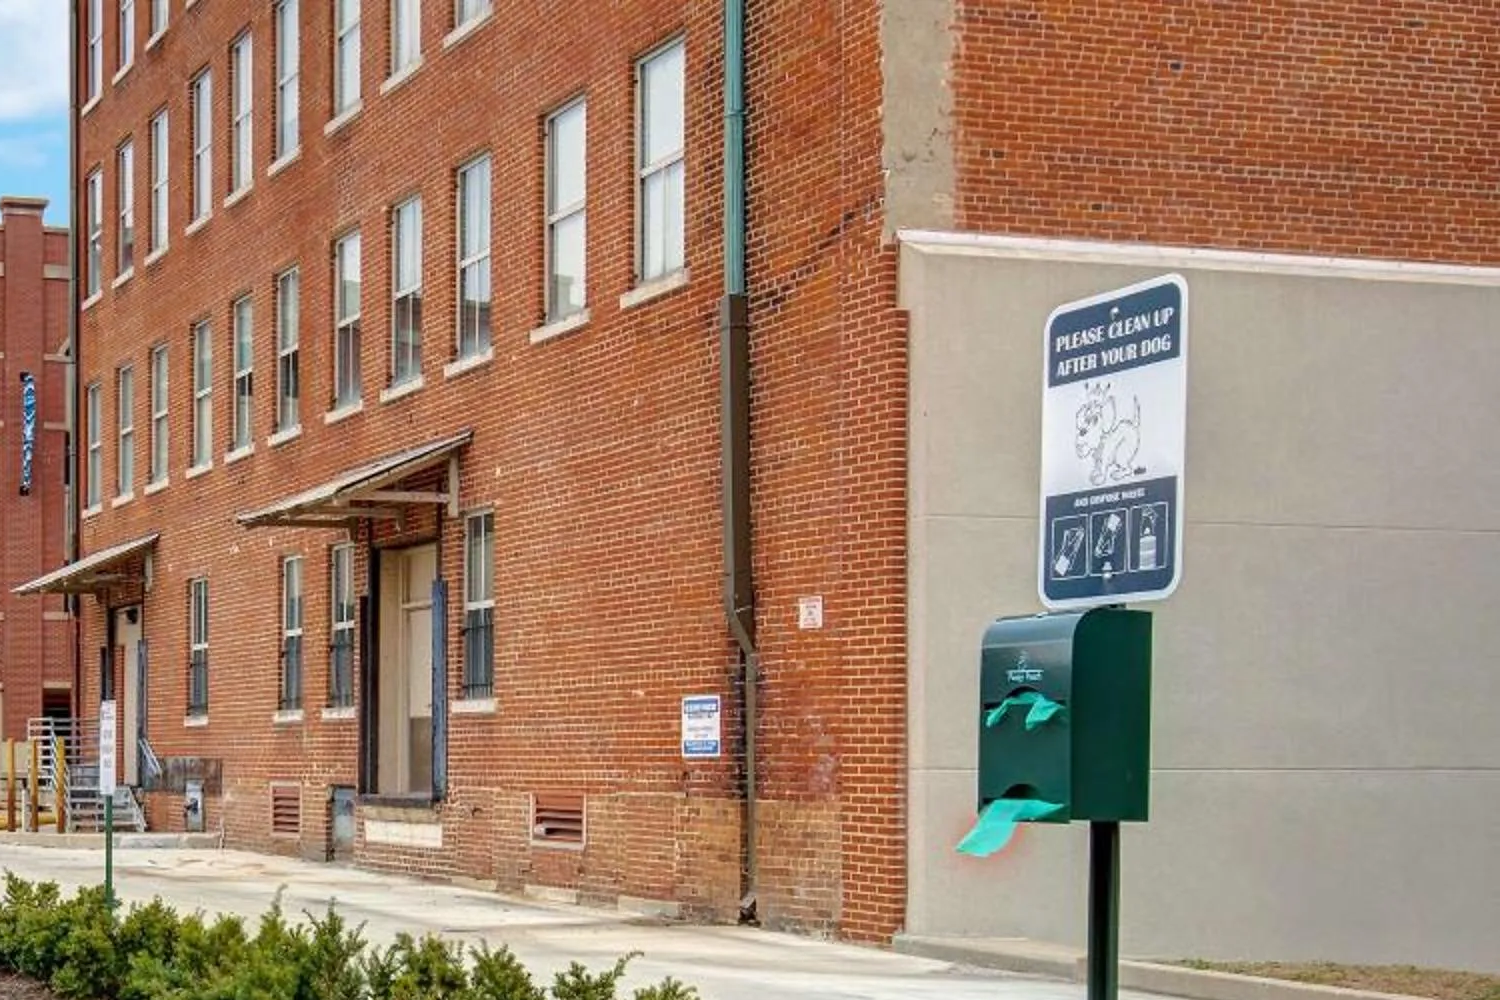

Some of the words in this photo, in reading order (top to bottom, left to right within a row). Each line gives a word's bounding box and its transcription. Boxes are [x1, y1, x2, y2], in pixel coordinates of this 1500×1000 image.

[1056, 325, 1105, 353] PLEASE
[1108, 312, 1151, 339] CLEAN
[1153, 306, 1175, 326] UP
[1057, 353, 1097, 377] AFTER
[1101, 343, 1138, 367] YOUR
[1141, 333, 1172, 357] DOG
